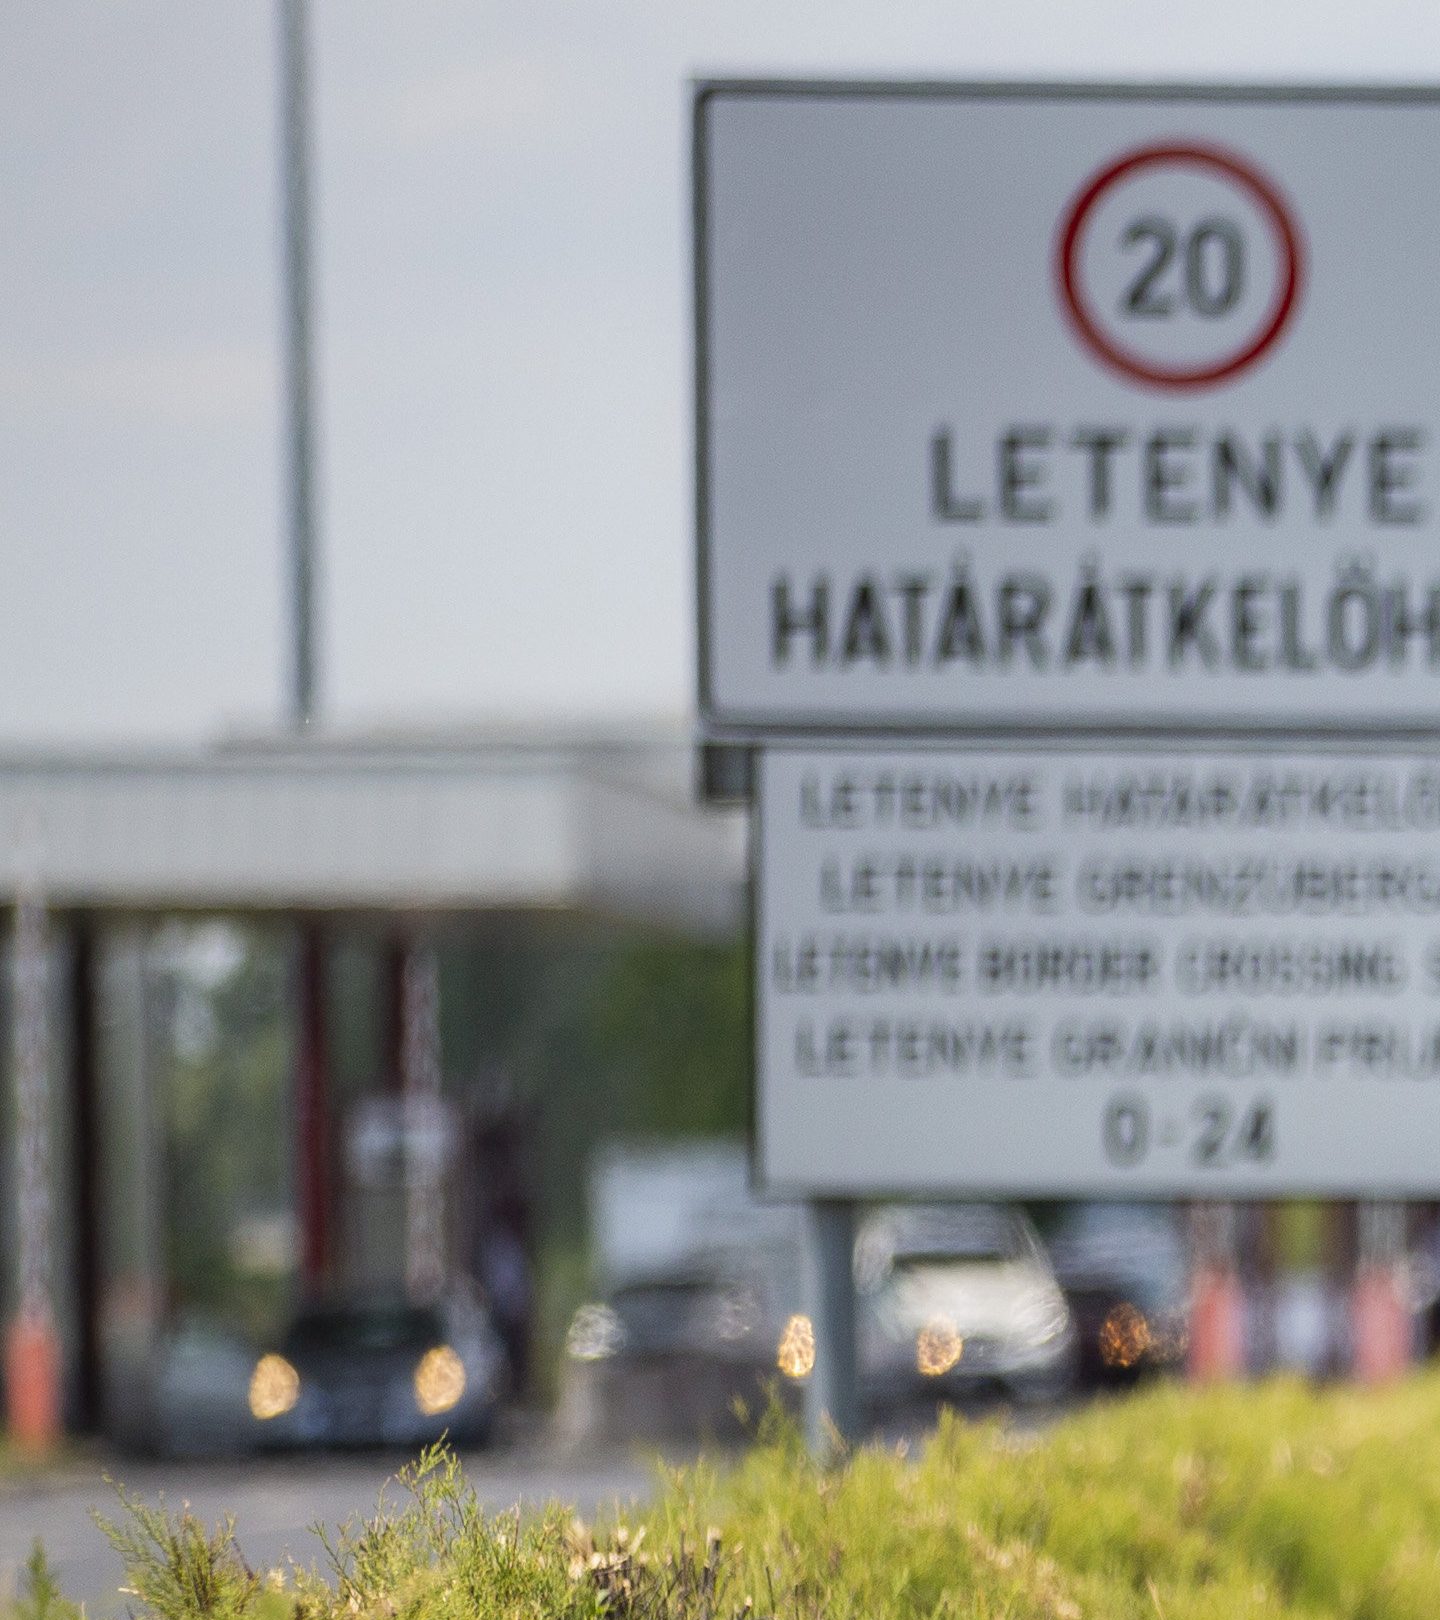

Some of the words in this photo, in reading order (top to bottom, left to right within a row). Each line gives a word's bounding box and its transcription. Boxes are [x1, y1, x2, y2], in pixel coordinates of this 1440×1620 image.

[1118, 213, 1246, 319] 20
[931, 424, 1430, 525] LETENYE
[799, 770, 1041, 828] LETENYE
[821, 857, 1063, 912] LETENYE
[773, 938, 967, 994] LETENYE
[979, 938, 1160, 994] BORDER
[1177, 938, 1404, 995] CROSSING
[796, 1022, 1038, 1077] LETENYE
